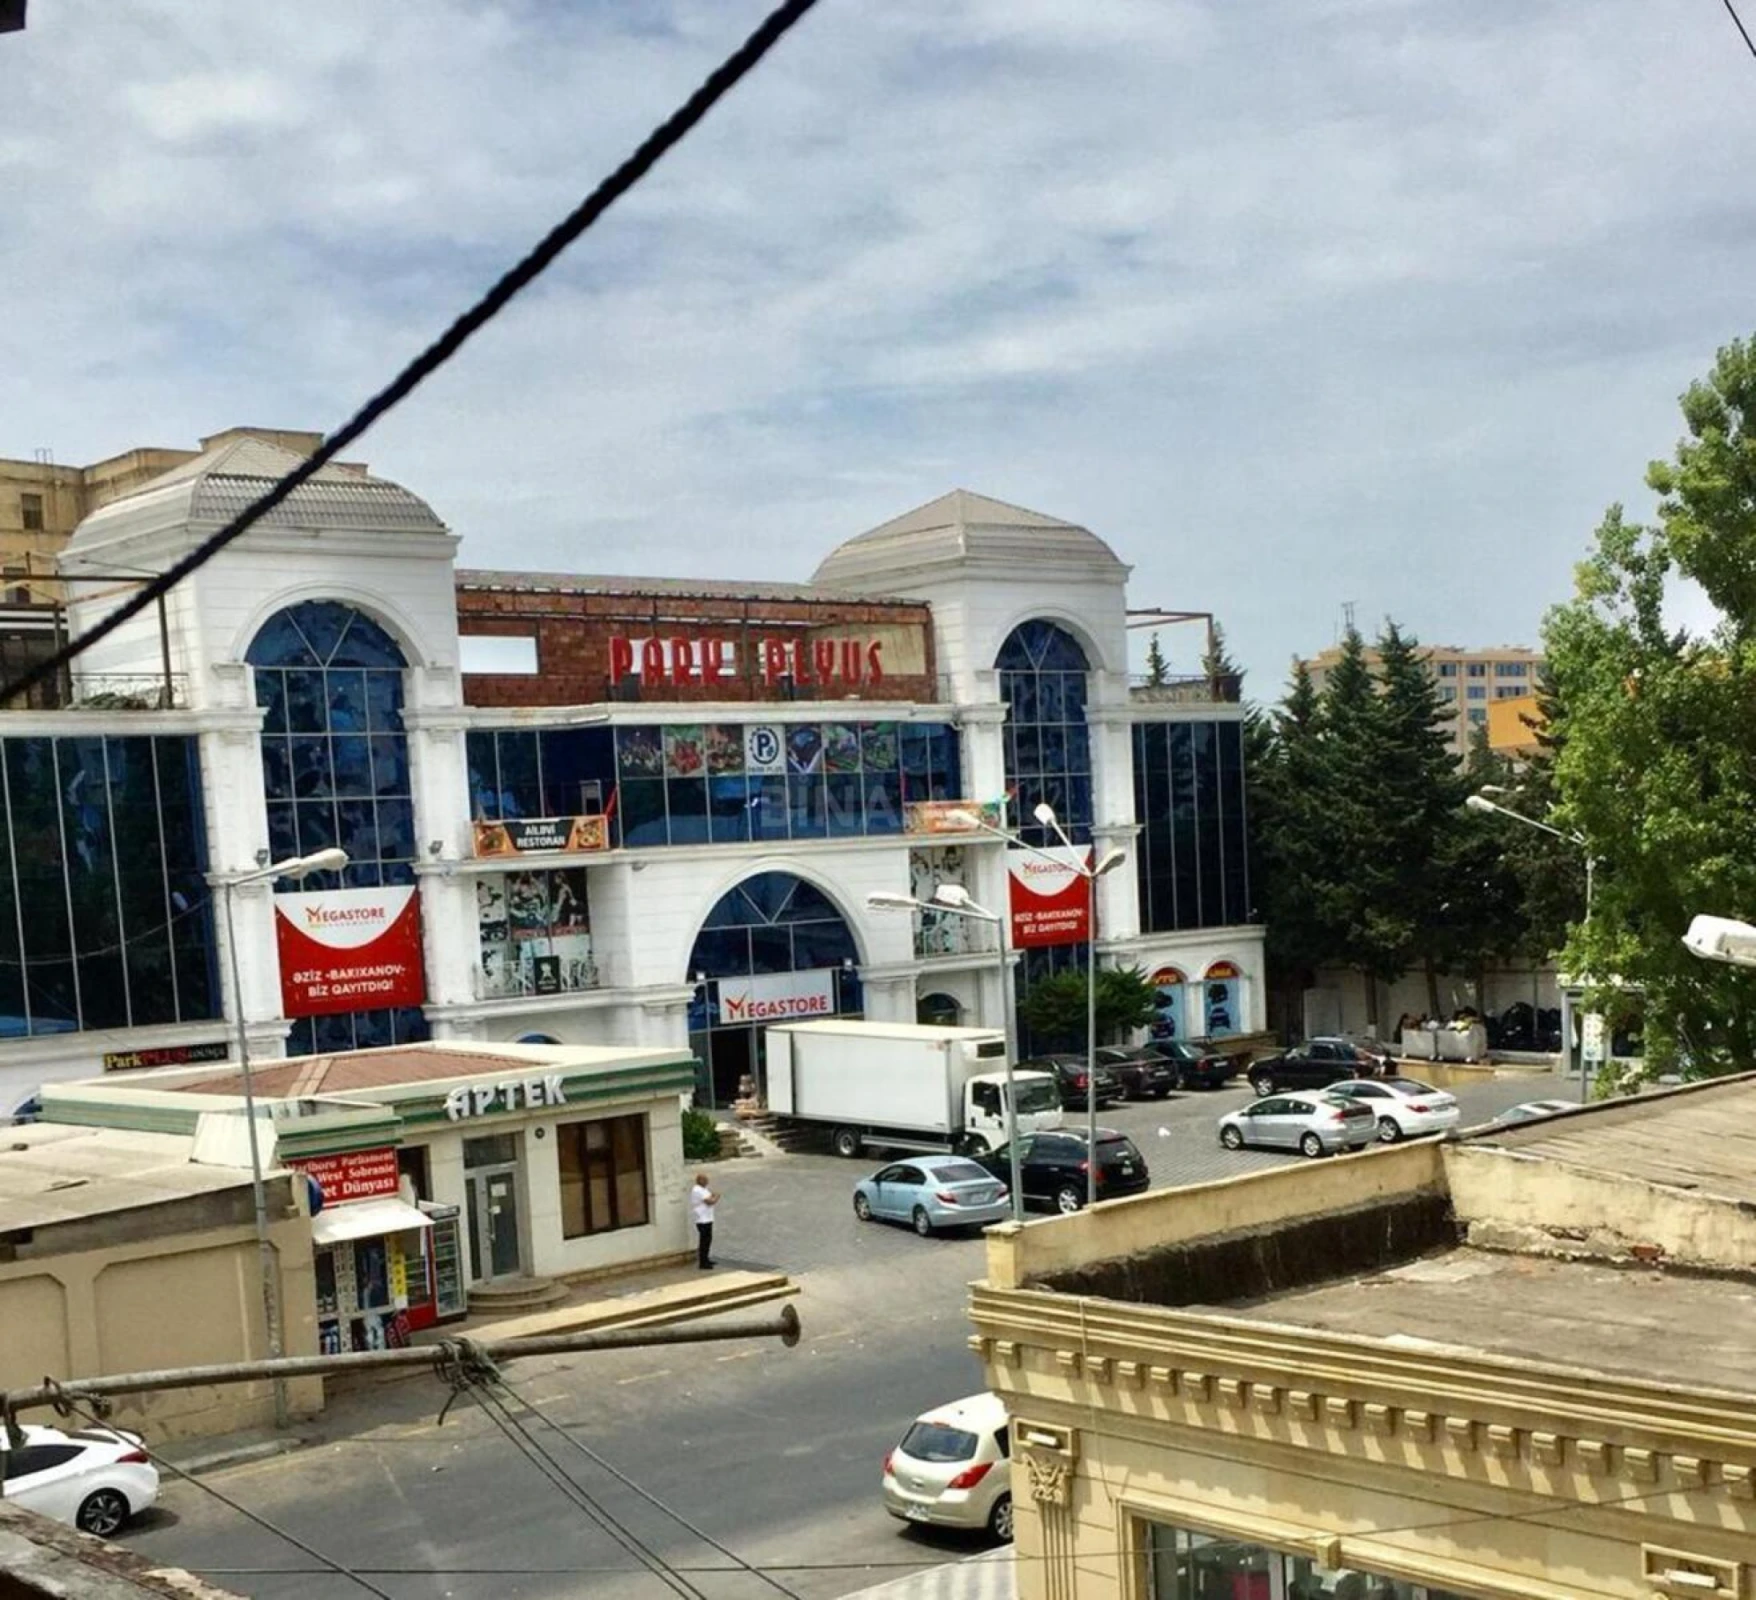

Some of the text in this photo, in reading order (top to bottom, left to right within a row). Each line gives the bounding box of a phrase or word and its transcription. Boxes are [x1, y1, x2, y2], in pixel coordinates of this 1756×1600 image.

[609, 636, 882, 686] PARK PLYUS
[516, 835, 565, 849] RESTORAN
[305, 903, 385, 923] MEGASTORE
[308, 983, 329, 997] BİZ
[725, 993, 828, 1020] MEGASTORE
[444, 1075, 566, 1122] APTEK
